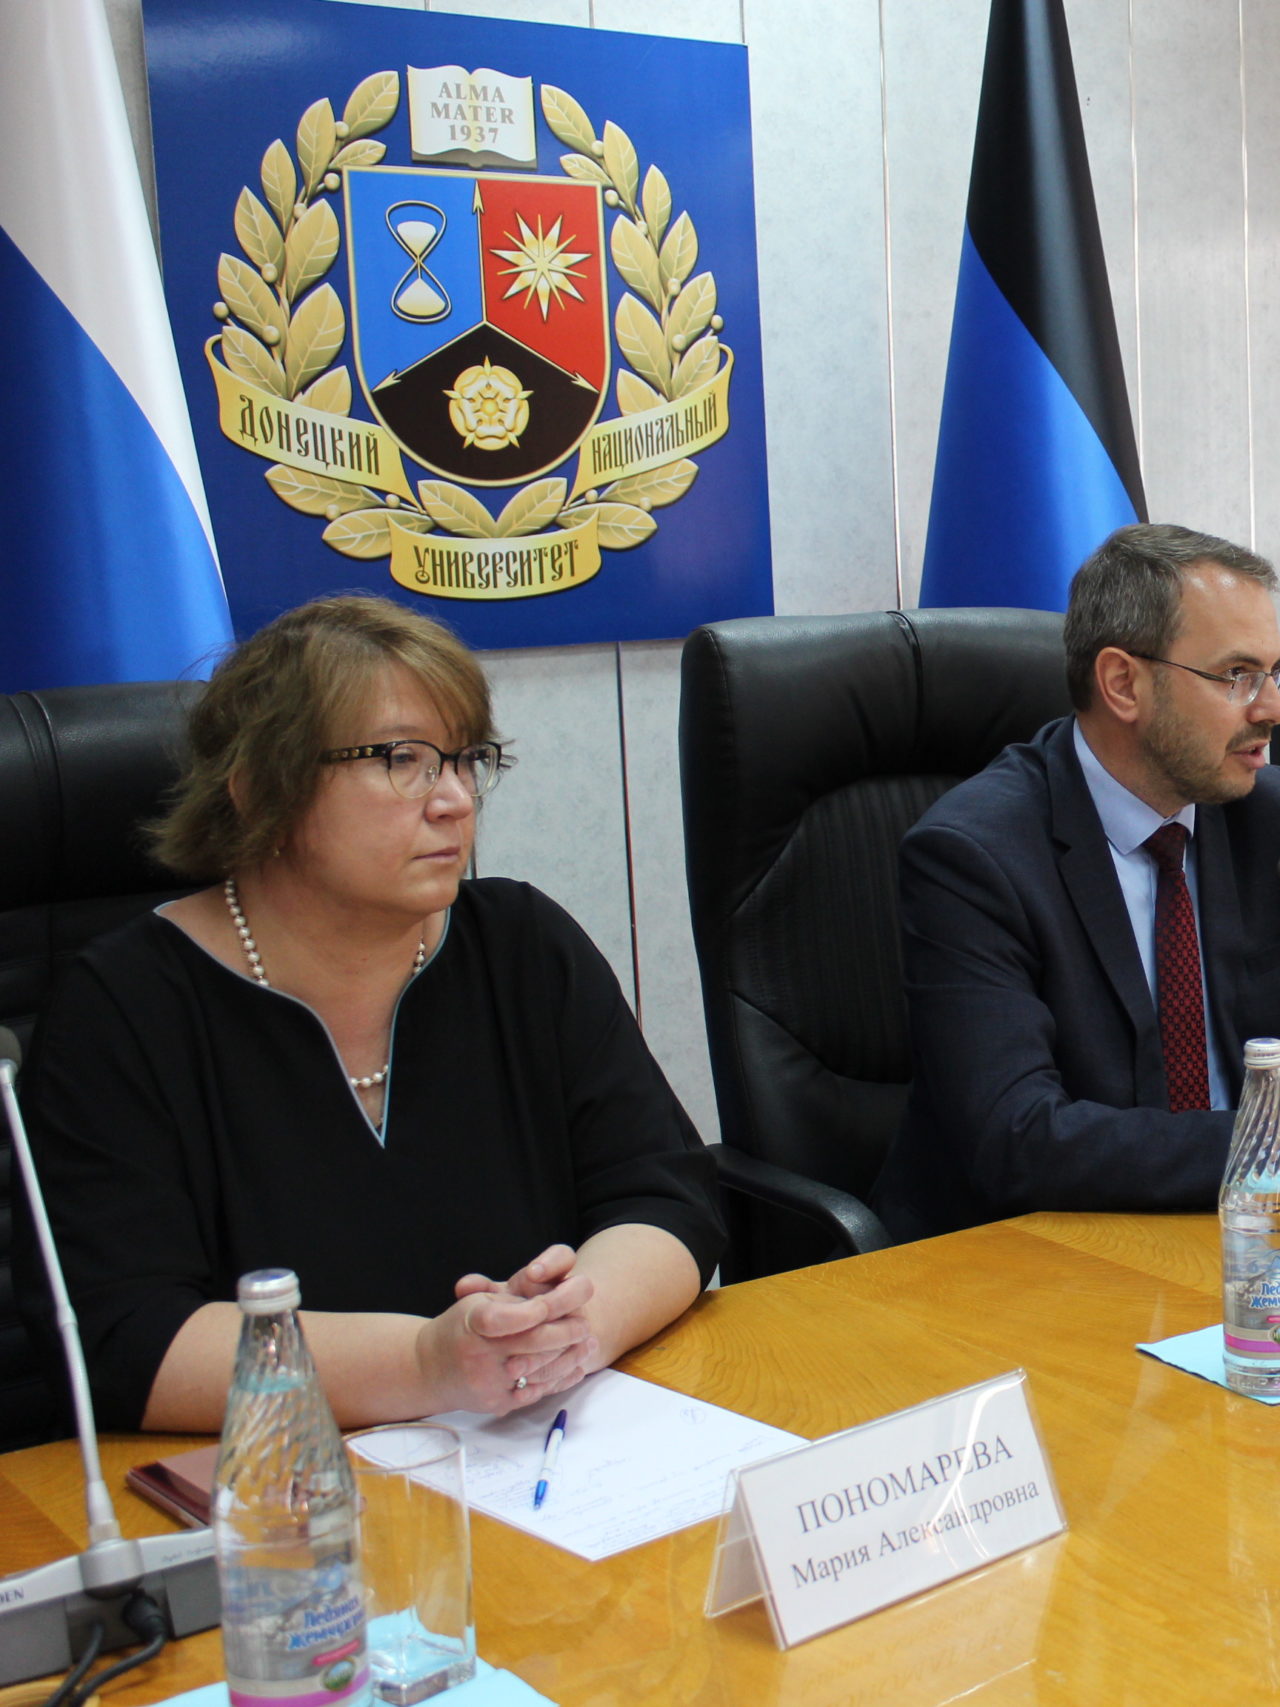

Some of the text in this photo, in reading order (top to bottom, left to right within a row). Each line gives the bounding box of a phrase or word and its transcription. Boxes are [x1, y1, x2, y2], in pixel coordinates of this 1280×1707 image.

[430, 102, 515, 126] MATER
[438, 80, 506, 103] ALMA
[448, 123, 499, 145] 1937
[238, 394, 381, 476] ДОНЕЦКИЙ
[591, 391, 719, 475] НАЦИОНАЛЬНЫЙ
[413, 537, 580, 590] УНИВЕРСИТЕТ
[796, 1434, 1013, 1534] ПОНОМАРЕВА
[790, 1480, 1040, 1589] Мария Александровна
